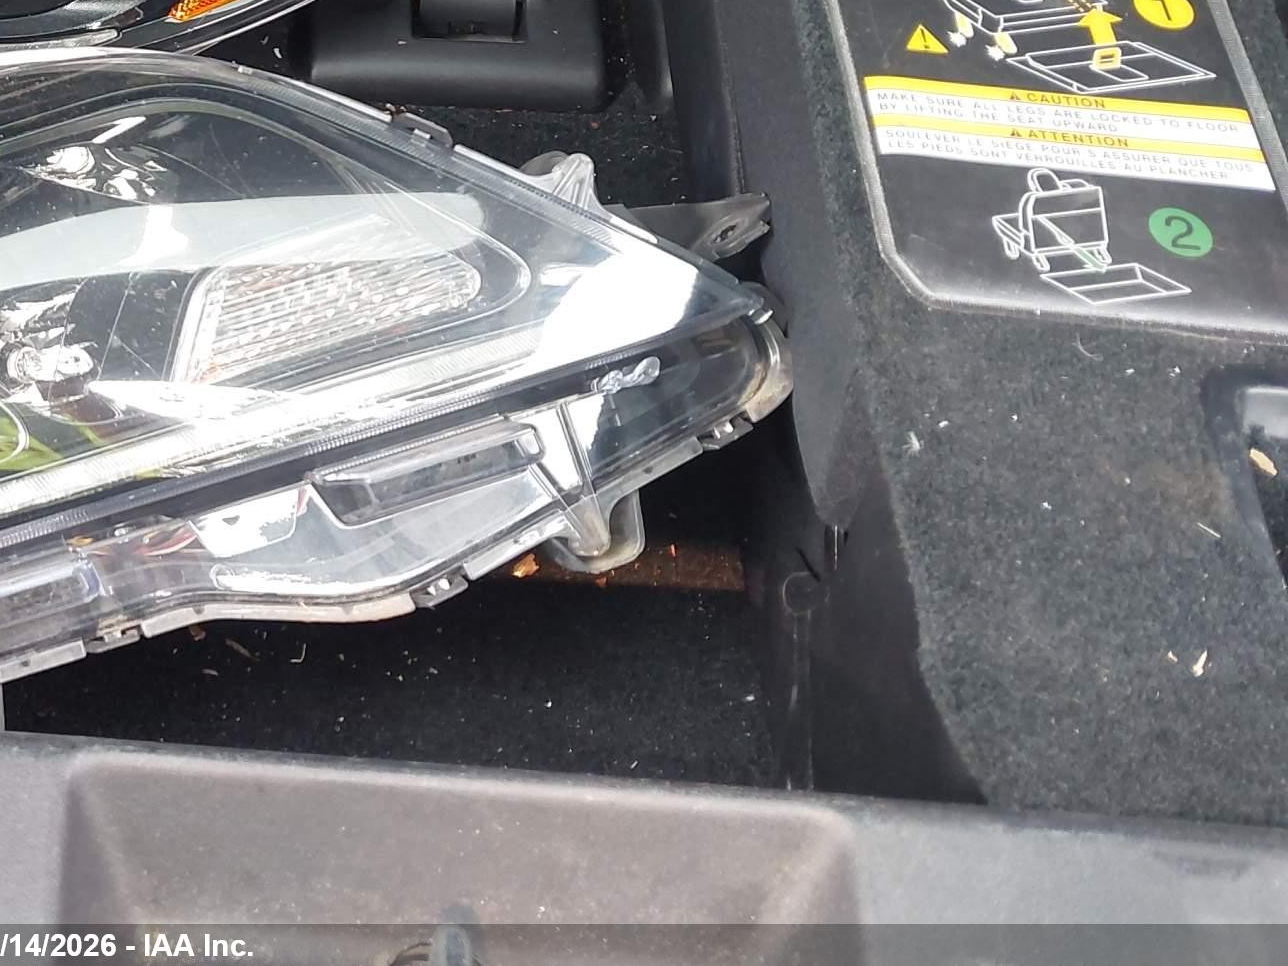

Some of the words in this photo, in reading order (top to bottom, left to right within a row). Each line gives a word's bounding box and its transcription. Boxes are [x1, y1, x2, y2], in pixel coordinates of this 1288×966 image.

[1027, 93, 1107, 110] CAUTION
[1029, 129, 1129, 148] ATTENTION
[1164, 214, 1202, 251] 2
